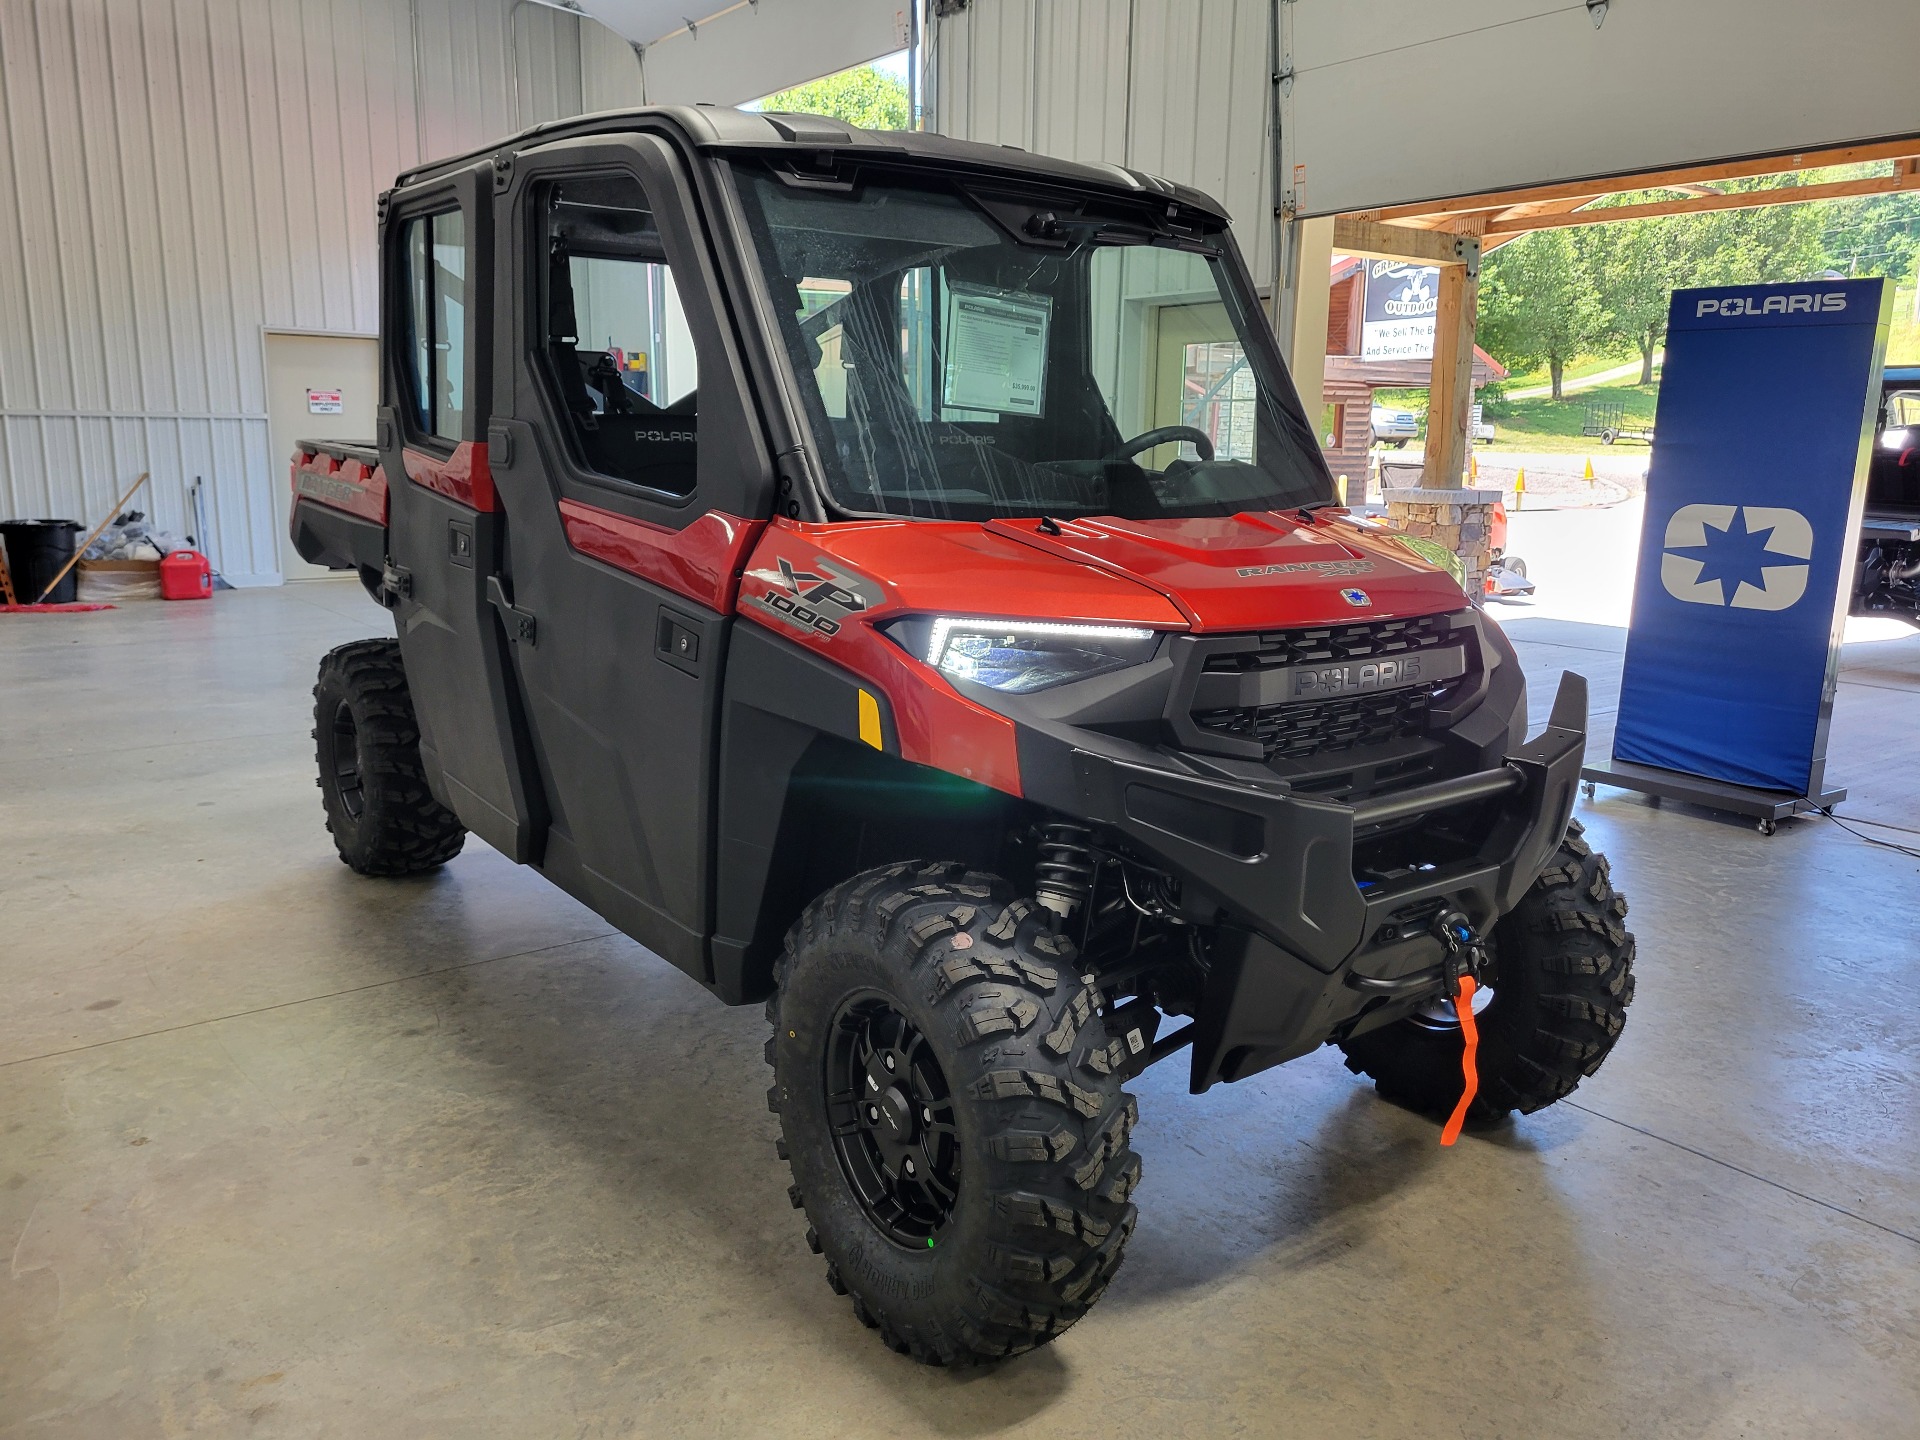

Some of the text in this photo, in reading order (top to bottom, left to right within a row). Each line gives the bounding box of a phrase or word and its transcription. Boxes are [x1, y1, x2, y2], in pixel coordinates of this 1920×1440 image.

[1387, 300, 1435, 313] OUTDOO
[1695, 292, 1847, 318] POLARIS
[1392, 327, 1407, 338] Sell
[1410, 326, 1425, 336] The
[1366, 343, 1429, 356] And Service The
[634, 430, 698, 442] POLARI
[940, 435, 996, 445] POLARIS
[1235, 560, 1378, 578] RANGER
[776, 555, 867, 612] XP
[763, 589, 842, 636] 1000
[760, 604, 777, 615] DUAL
[813, 630, 832, 643] CAM
[1294, 656, 1421, 696] POLARIS
